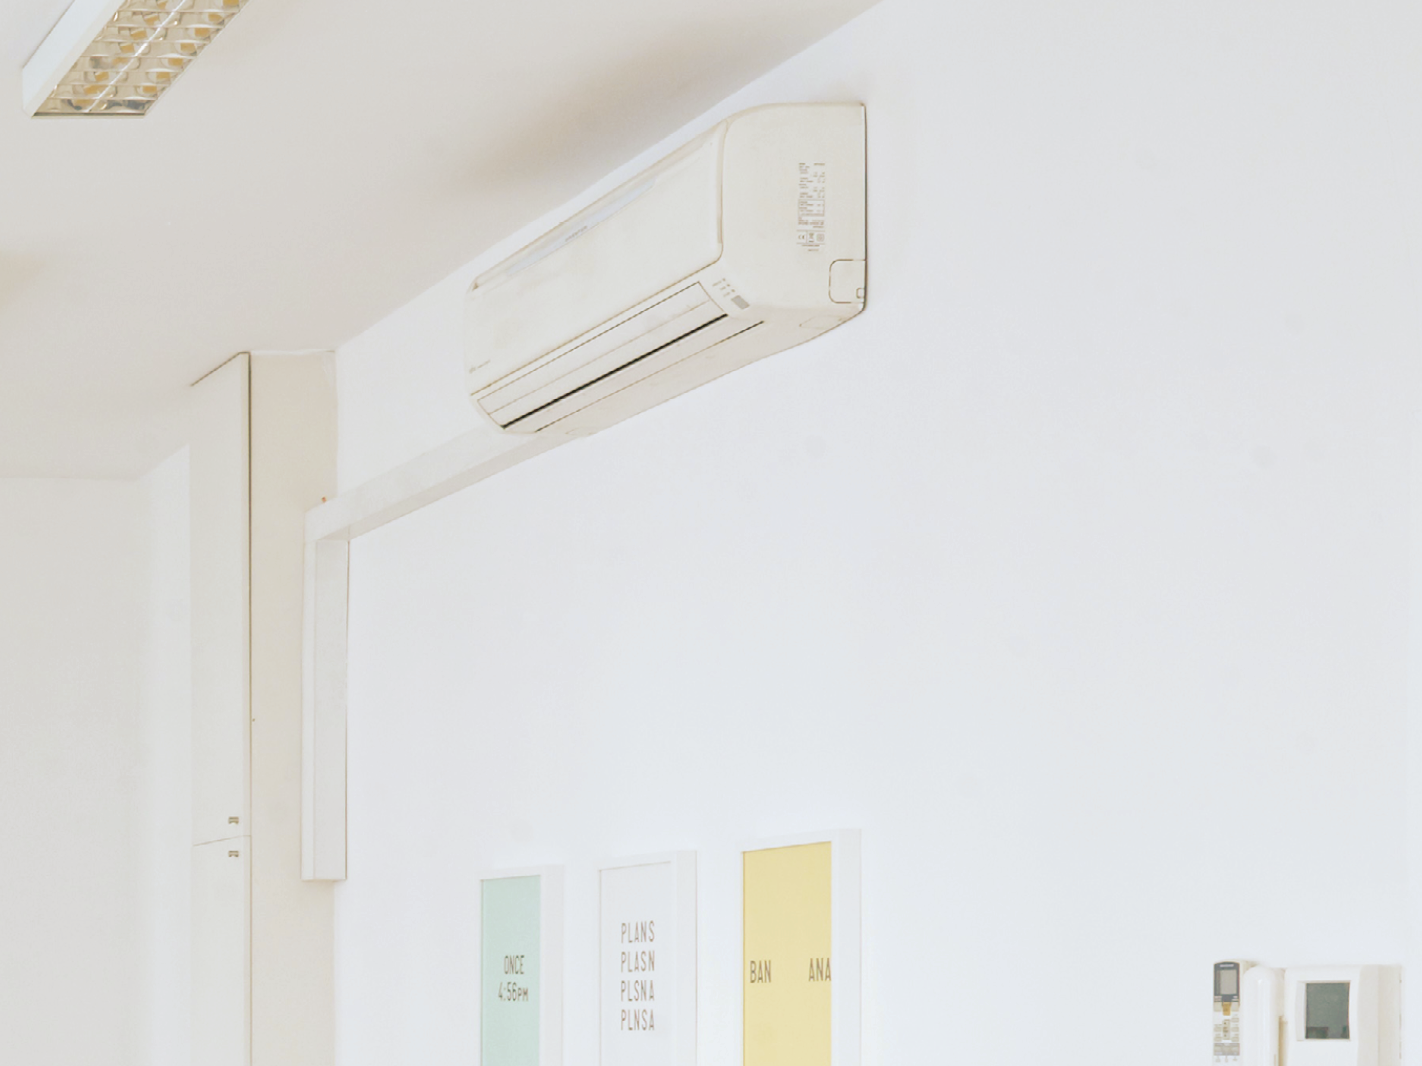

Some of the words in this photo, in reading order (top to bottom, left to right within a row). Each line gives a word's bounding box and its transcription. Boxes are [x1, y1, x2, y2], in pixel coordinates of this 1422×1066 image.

[621, 920, 655, 943] PLANS
[503, 954, 525, 975] ONCE
[621, 950, 655, 973] PLASN
[750, 960, 771, 983] BAN
[808, 957, 832, 982] ANA
[621, 979, 655, 1002] PLSNA
[621, 1008, 655, 1031] PLNSA
